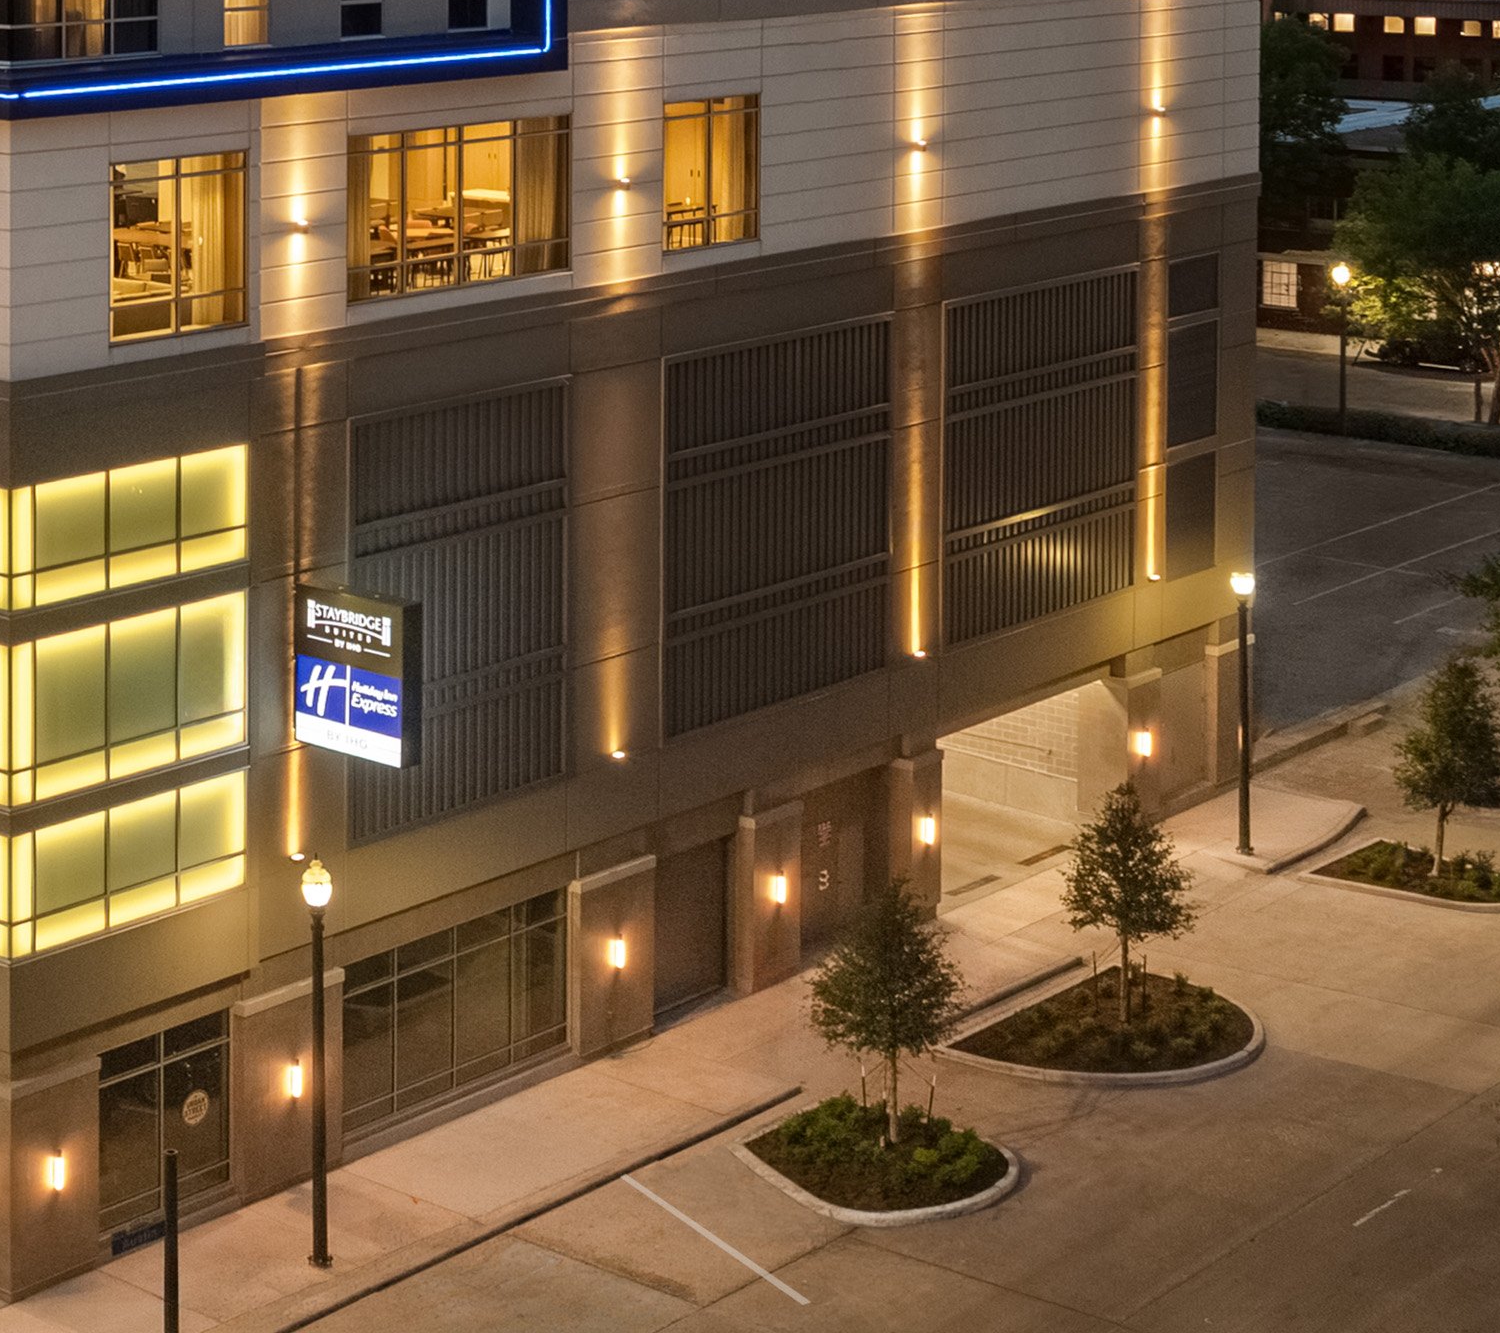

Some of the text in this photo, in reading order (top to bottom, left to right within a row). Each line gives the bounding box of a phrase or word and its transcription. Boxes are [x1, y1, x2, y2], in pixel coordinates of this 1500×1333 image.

[315, 605, 382, 631] STAYBRIDGE
[324, 625, 372, 643] SUITES
[351, 693, 398, 718] Express
